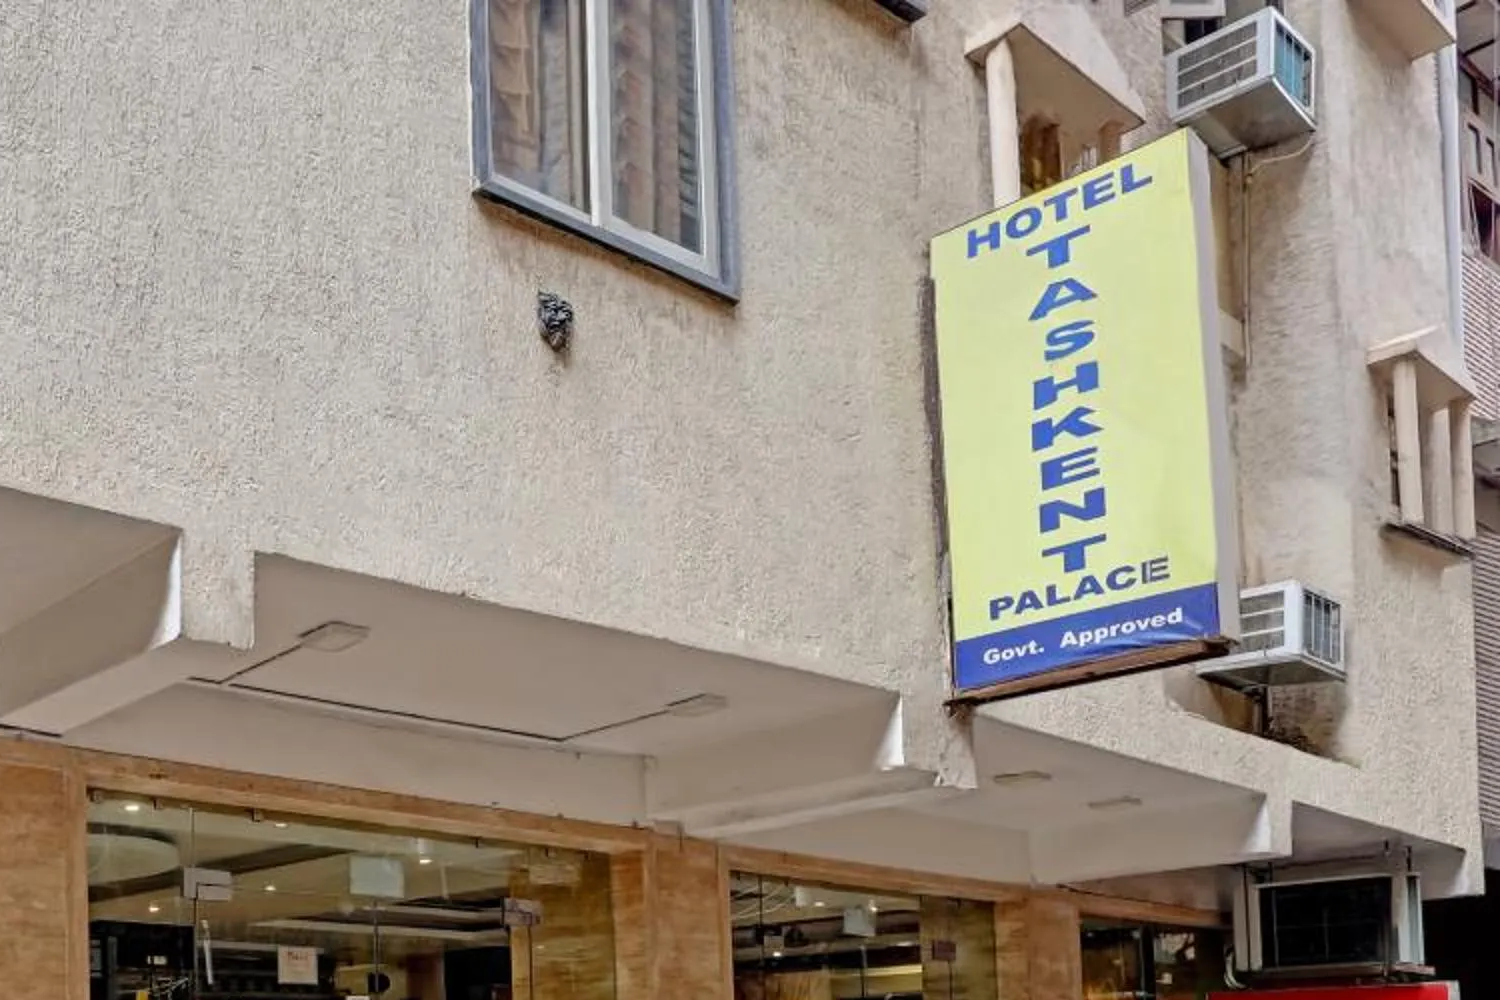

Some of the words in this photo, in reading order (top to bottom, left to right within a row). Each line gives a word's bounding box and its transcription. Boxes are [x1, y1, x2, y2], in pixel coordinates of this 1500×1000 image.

[966, 162, 1153, 259] HOTEL
[1025, 223, 1107, 575] TASHKENT
[989, 555, 1170, 622] PALACE
[983, 639, 1045, 666] Govt.
[1059, 606, 1184, 649] Approved
